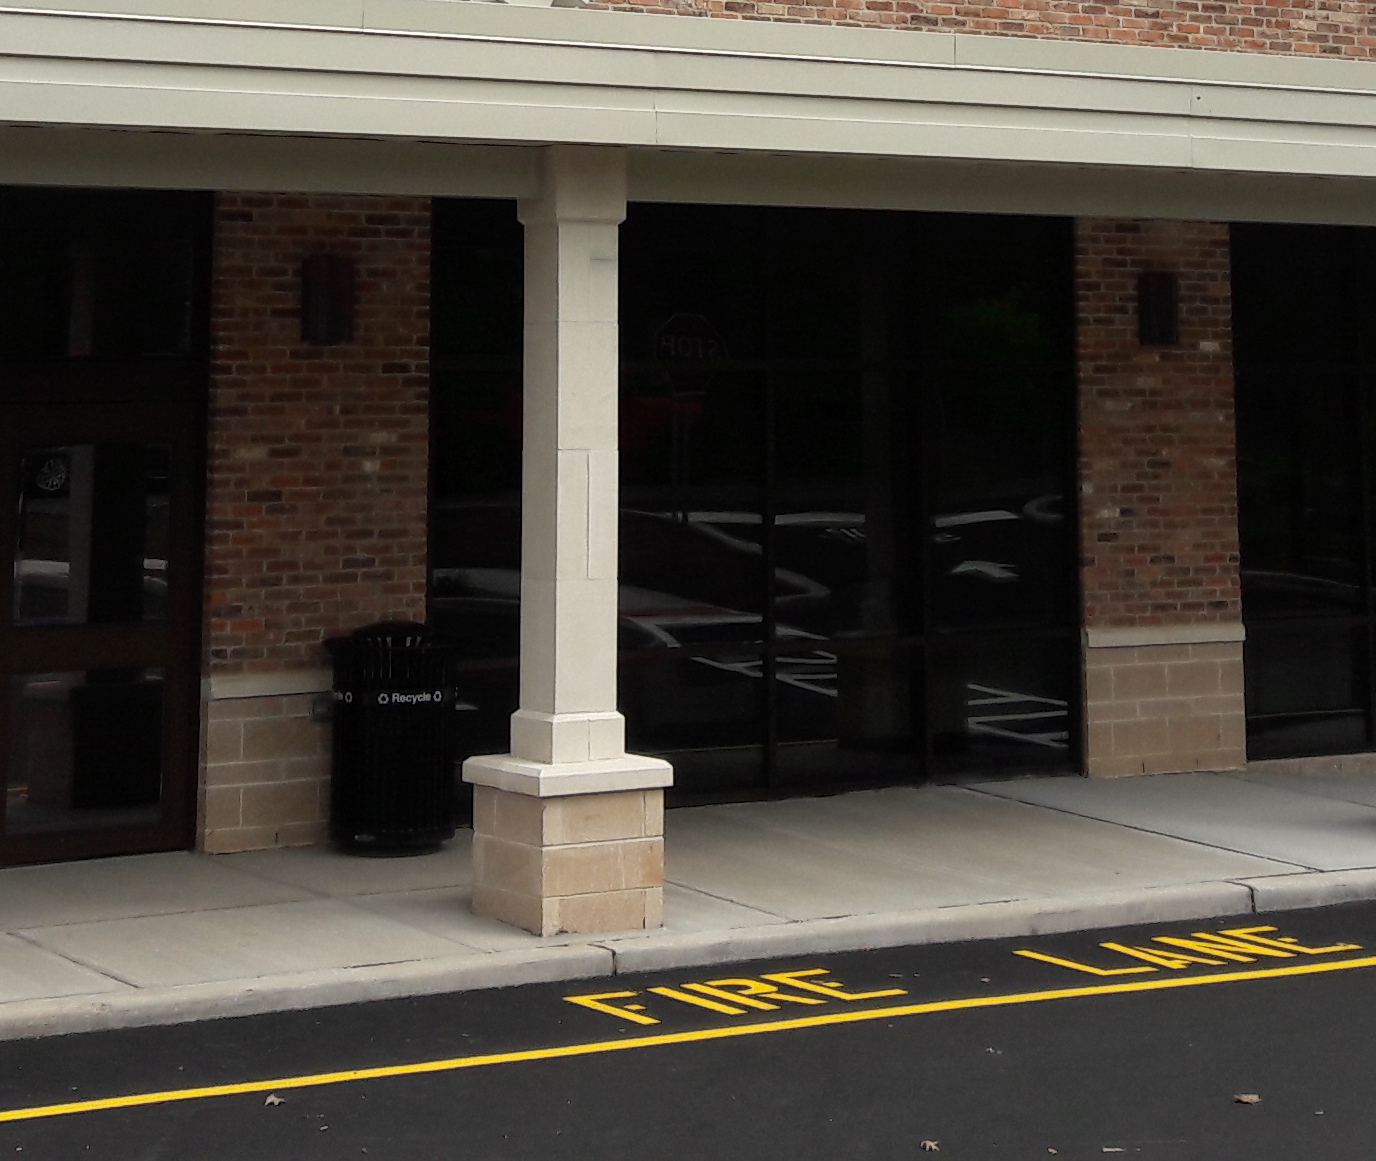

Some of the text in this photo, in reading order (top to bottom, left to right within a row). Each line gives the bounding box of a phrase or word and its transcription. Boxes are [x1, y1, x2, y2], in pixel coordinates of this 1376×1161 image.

[391, 691, 432, 706] Recycle
[563, 925, 1365, 1026] FIRE LANE
